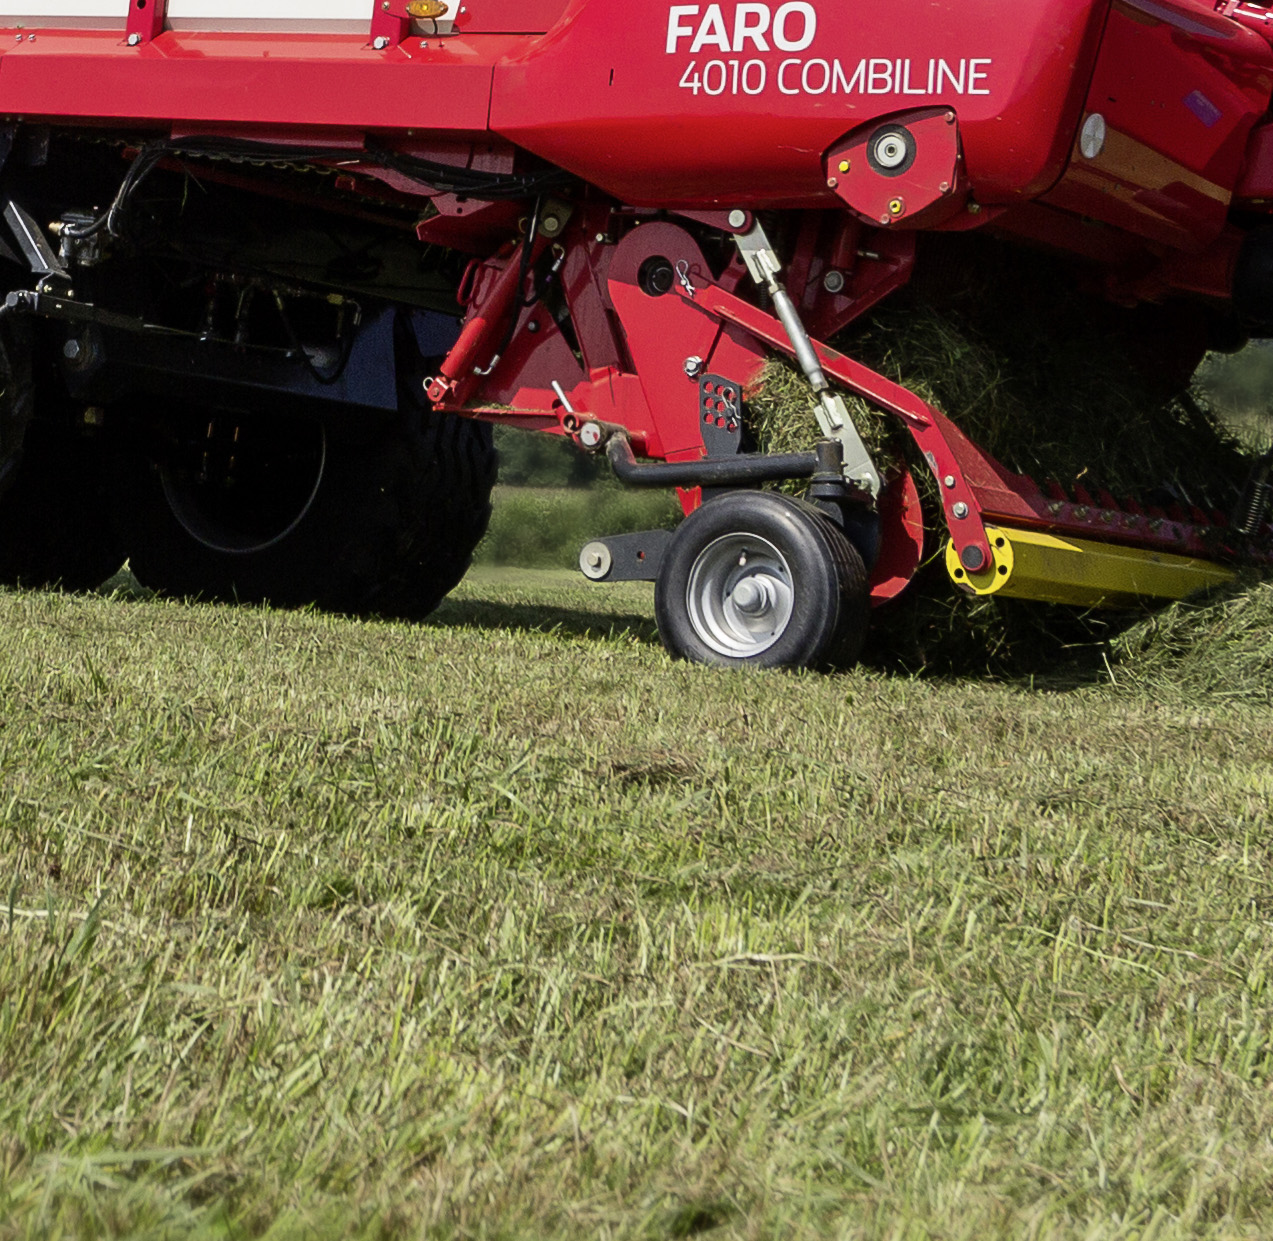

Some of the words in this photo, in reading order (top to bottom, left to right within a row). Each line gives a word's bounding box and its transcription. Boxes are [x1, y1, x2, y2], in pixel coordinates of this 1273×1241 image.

[665, 1, 817, 54] FARO
[679, 59, 766, 96] 4010
[777, 58, 992, 96] COMBILINE
